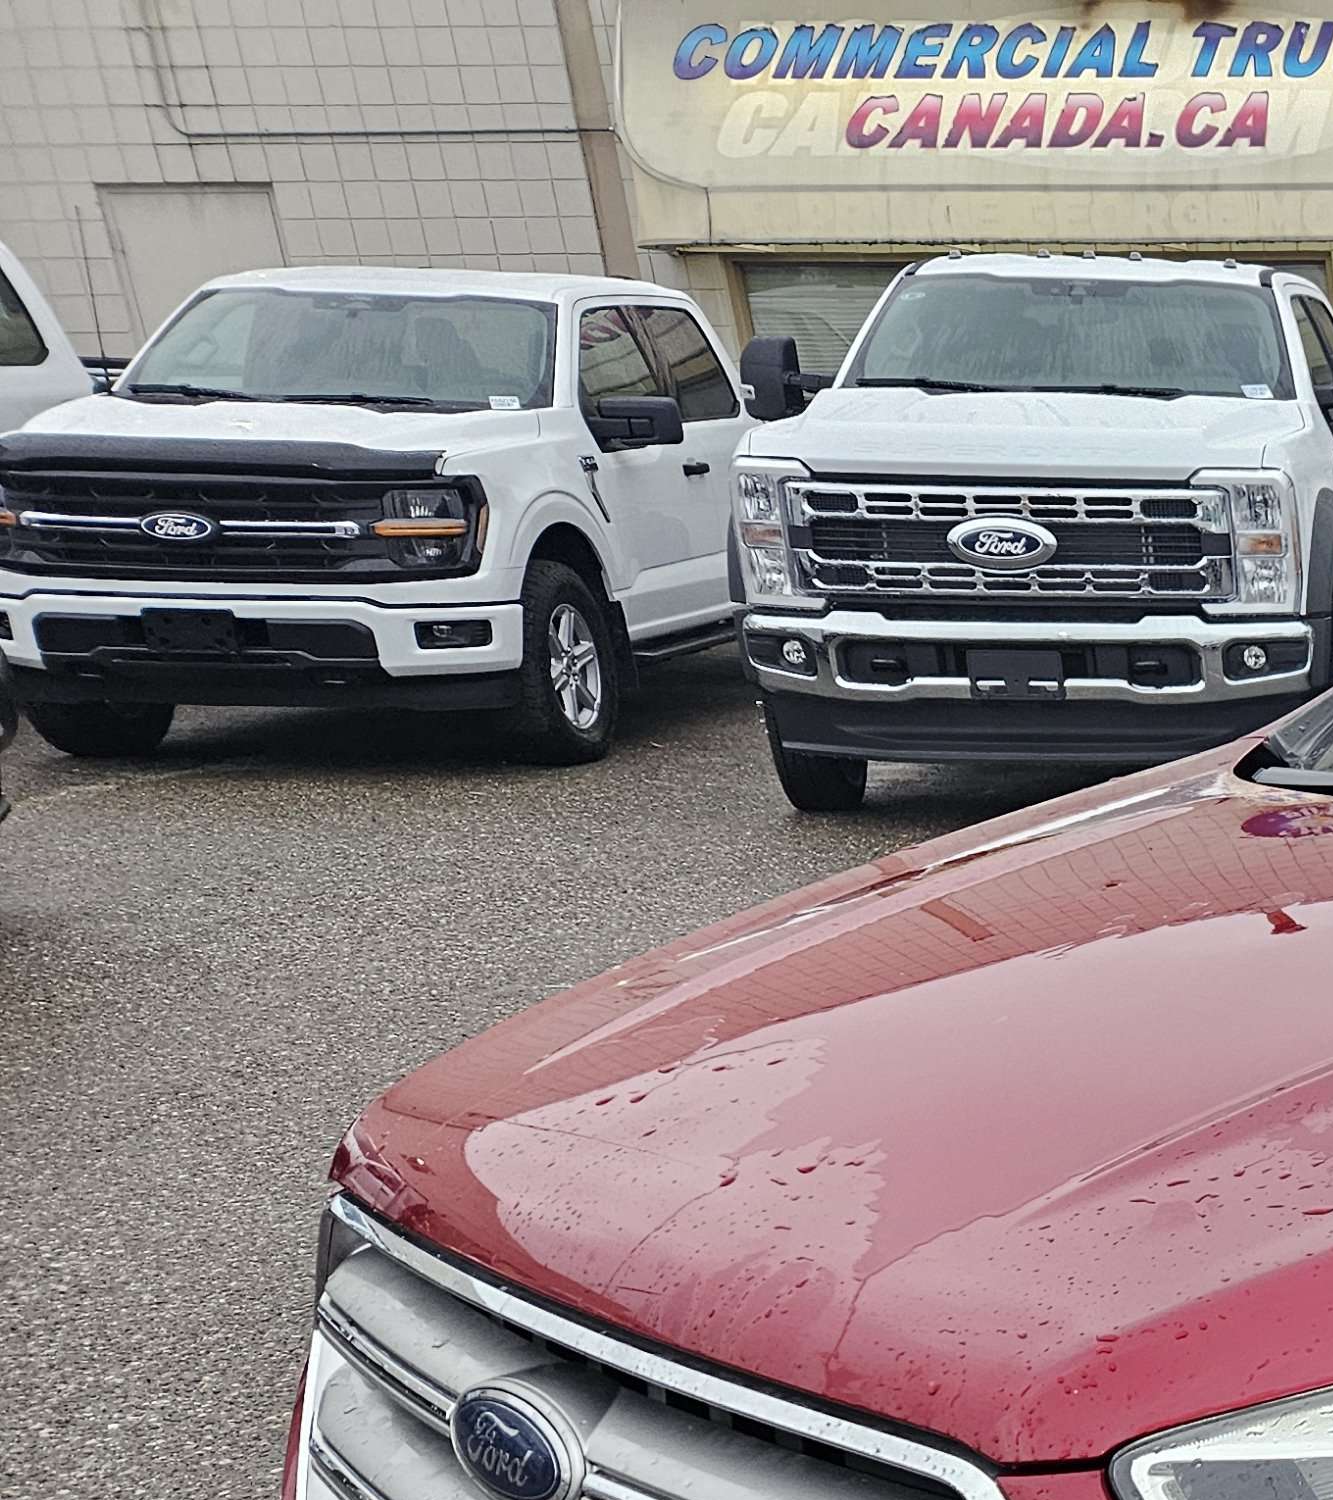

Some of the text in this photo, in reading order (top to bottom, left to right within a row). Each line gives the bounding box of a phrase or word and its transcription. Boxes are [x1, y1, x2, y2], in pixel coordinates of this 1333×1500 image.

[672, 20, 1159, 81] COMMERCIAL
[845, 91, 1270, 150] CANADA.CA
[154, 517, 198, 536] Ford
[974, 530, 1027, 554] Ford
[467, 1411, 533, 1487] Ford
